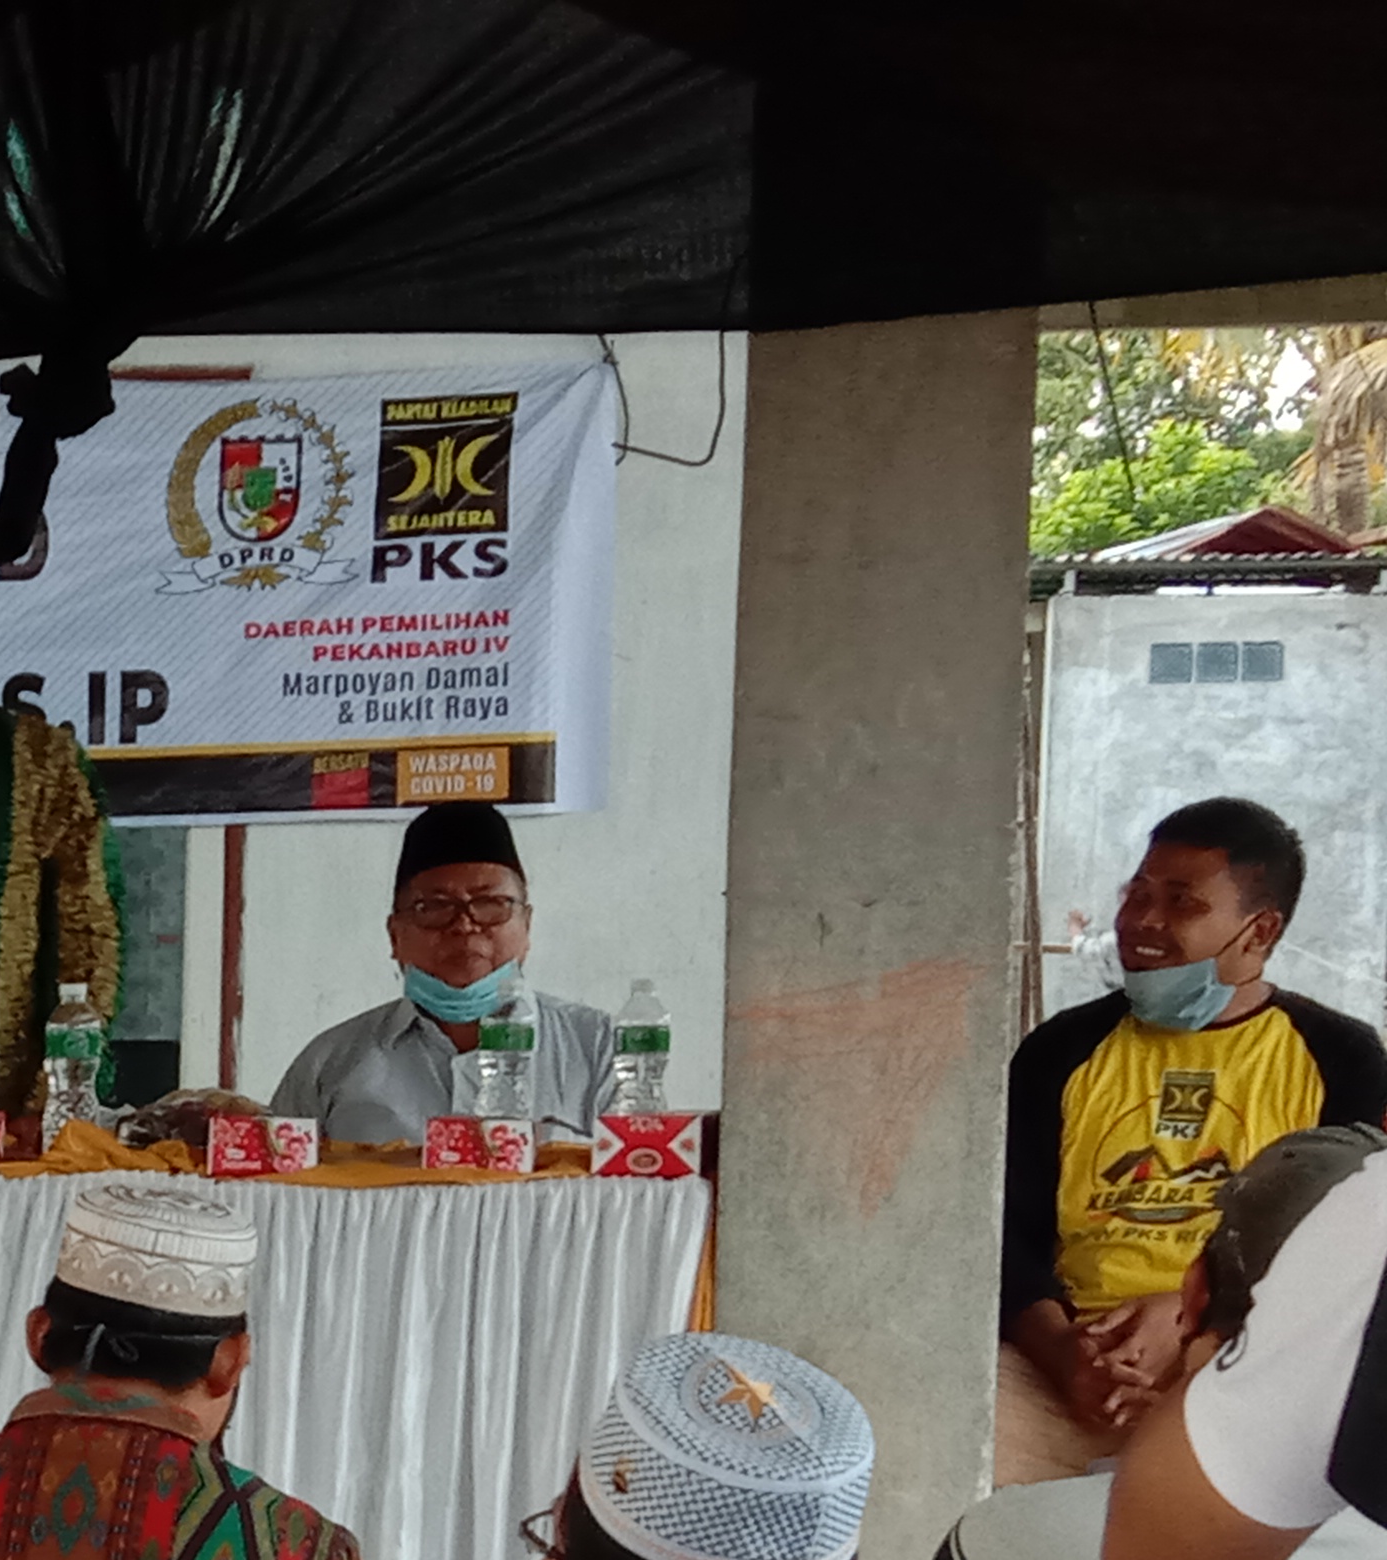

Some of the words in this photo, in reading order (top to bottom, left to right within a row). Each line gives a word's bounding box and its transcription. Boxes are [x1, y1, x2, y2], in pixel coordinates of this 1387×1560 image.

[387, 401, 438, 420] PARTAI
[440, 396, 513, 418] KEADILAN
[387, 509, 496, 532] SEJAHTERA
[218, 548, 295, 570] DPRD
[371, 538, 508, 584] PKS
[243, 617, 354, 640] DAERAH
[361, 609, 511, 634] PEMILIHAN
[312, 639, 477, 662] PEKANBARU
[483, 636, 511, 653] IV
[282, 670, 414, 698] Marpoyan
[426, 661, 510, 690] Damai
[338, 700, 354, 725] &
[366, 696, 434, 724] Bukit
[445, 695, 509, 722] Raya
[409, 752, 497, 774] WASPADA
[410, 774, 496, 795] COVID-19
[1155, 1122, 1204, 1140] PKS
[1123, 1227, 1168, 1242] PKS
